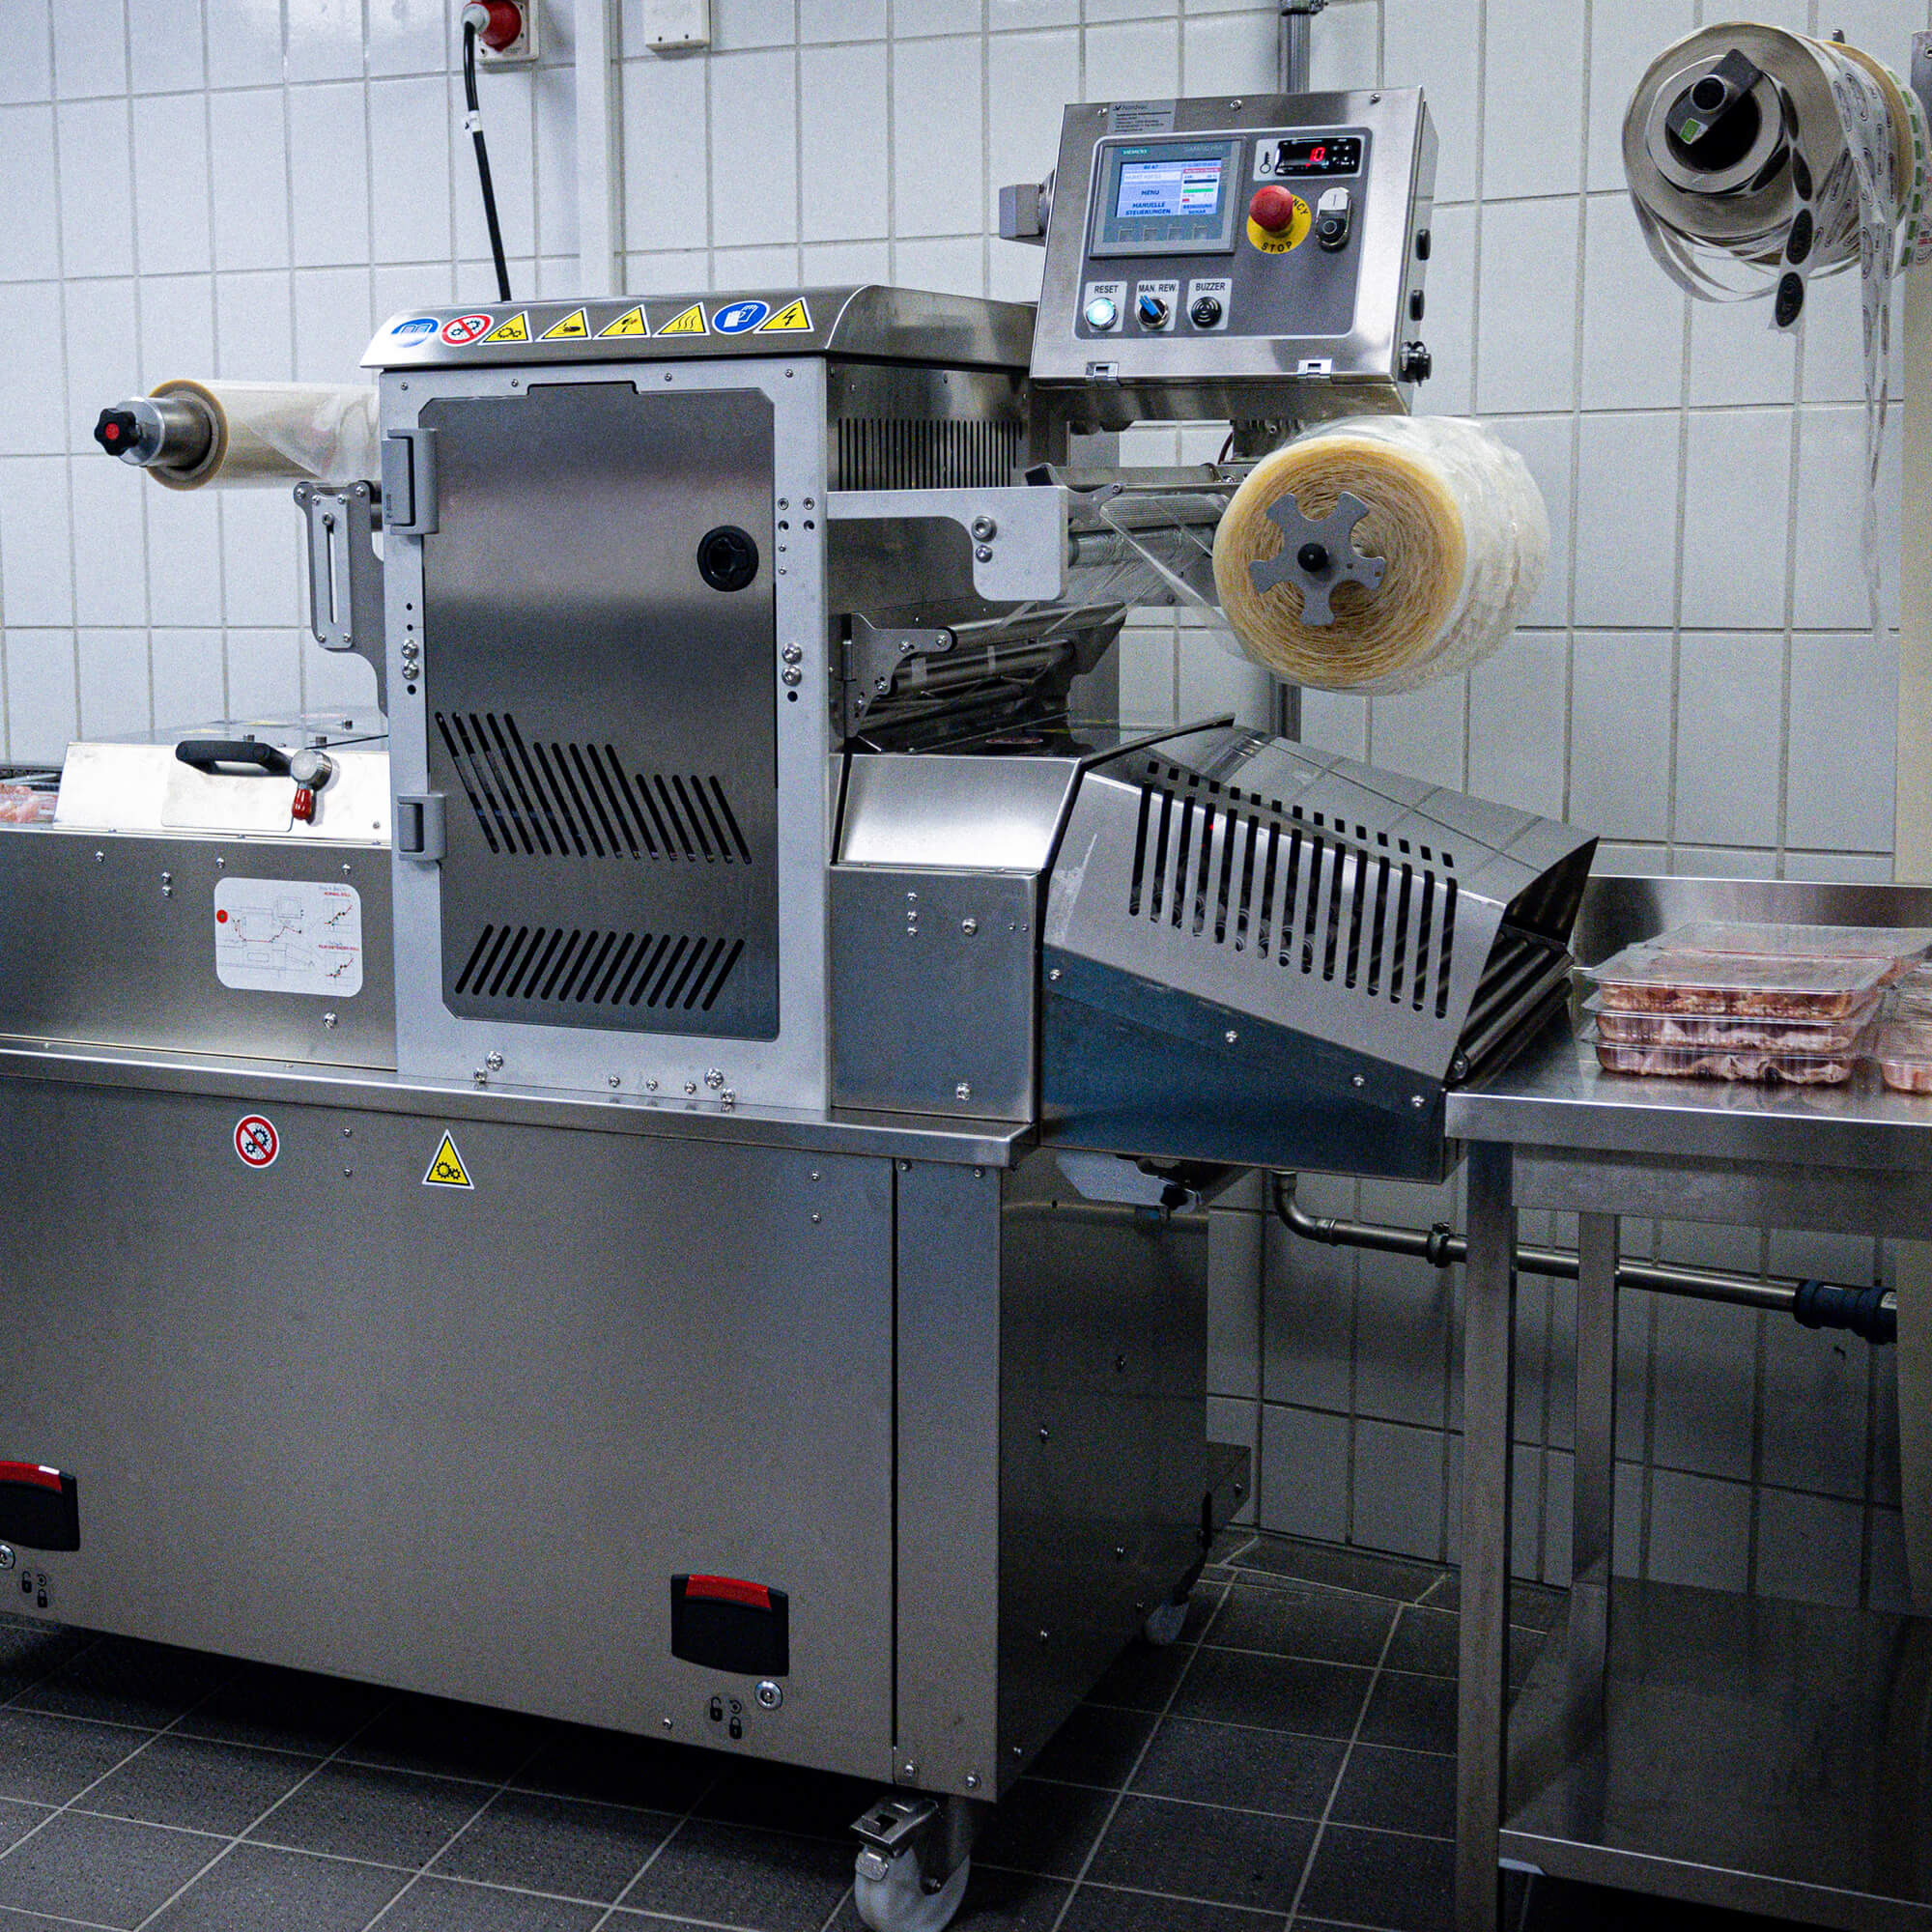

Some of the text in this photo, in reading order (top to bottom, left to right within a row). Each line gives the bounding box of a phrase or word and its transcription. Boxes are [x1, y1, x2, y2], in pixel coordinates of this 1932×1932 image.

[1261, 241, 1293, 252] STOP
[1094, 285, 1119, 294] RESET
[1138, 283, 1177, 293] MAN REW
[1195, 282, 1226, 291] BUZZER
